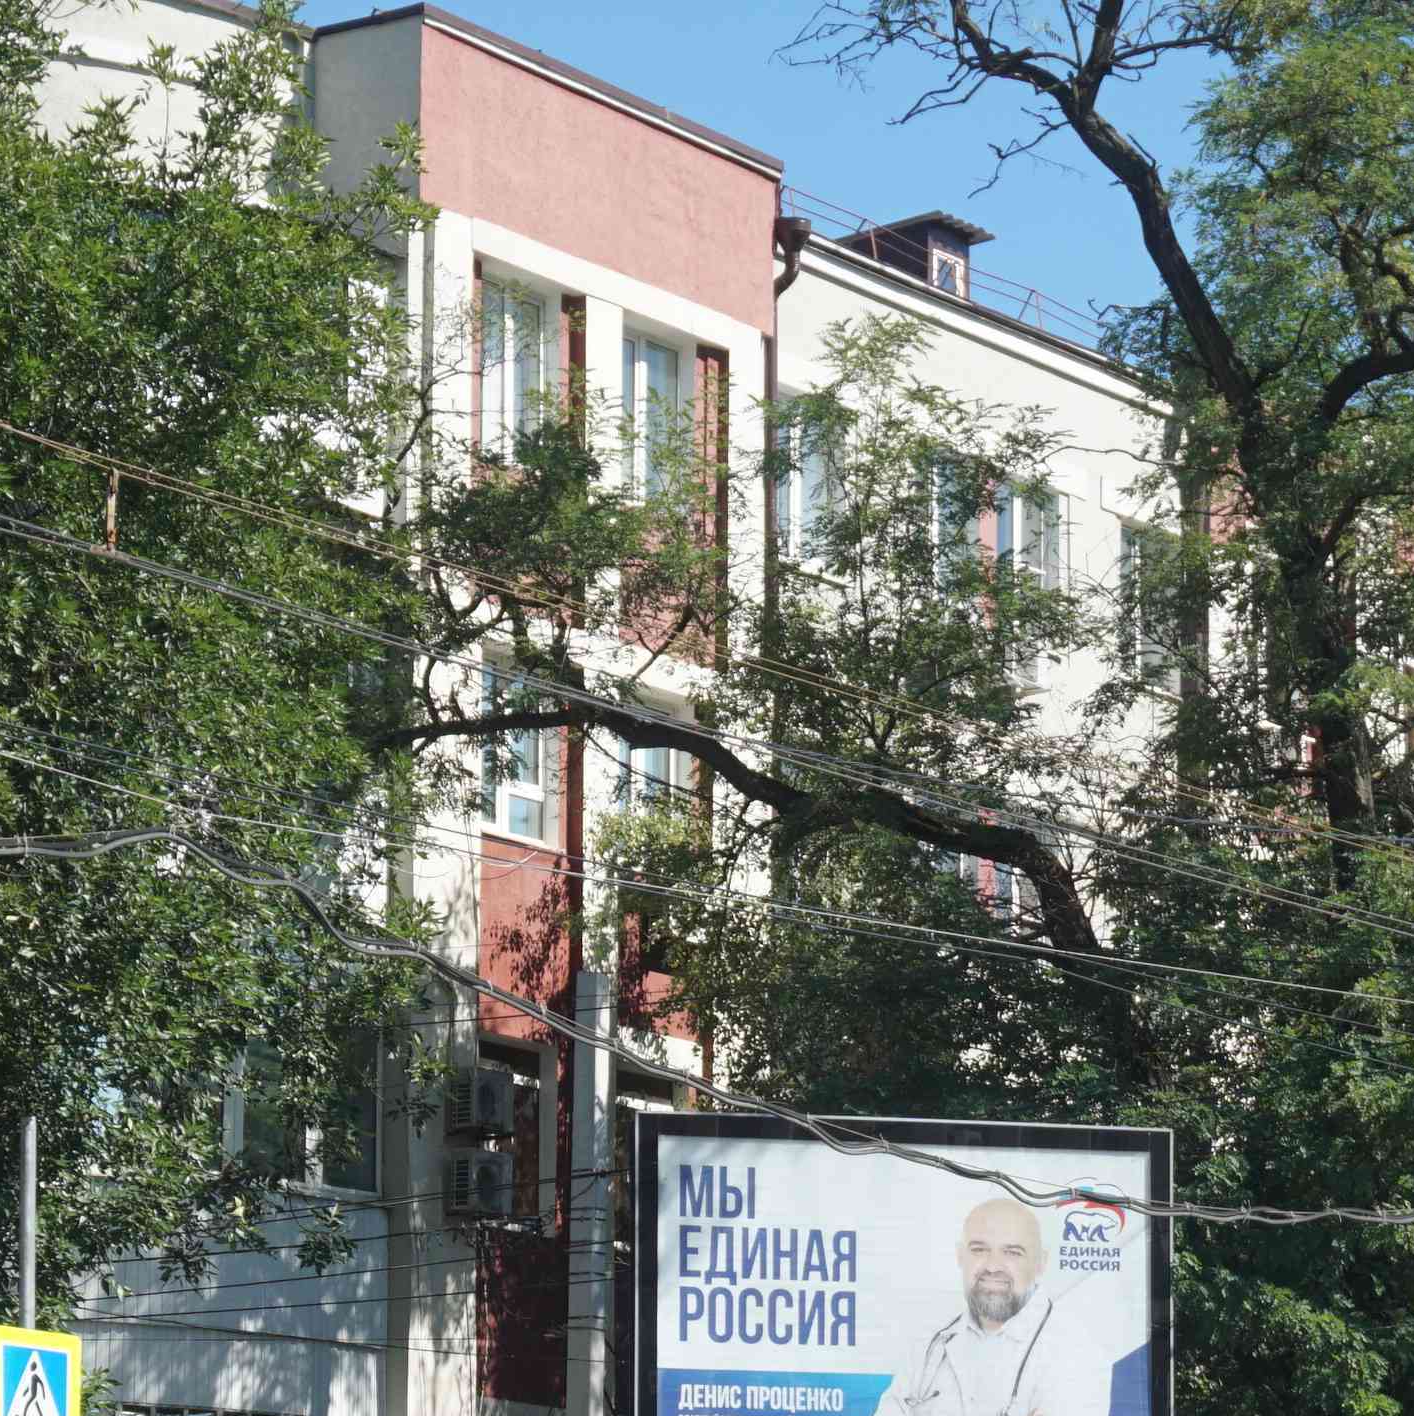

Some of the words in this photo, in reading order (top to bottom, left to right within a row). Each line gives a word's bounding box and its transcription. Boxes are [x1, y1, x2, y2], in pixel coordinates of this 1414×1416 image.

[679, 1164, 756, 1219] МЫ
[679, 1224, 857, 1286] ЕДИНАЯ
[1059, 1246, 1120, 1258] ЕДИНАЯ
[1059, 1259, 1120, 1272] РОССИЯ
[679, 1286, 857, 1347] РОССИЯ
[678, 1383, 741, 1410] ДЕНИС
[746, 1385, 844, 1413] ПРОЦЕНКО
